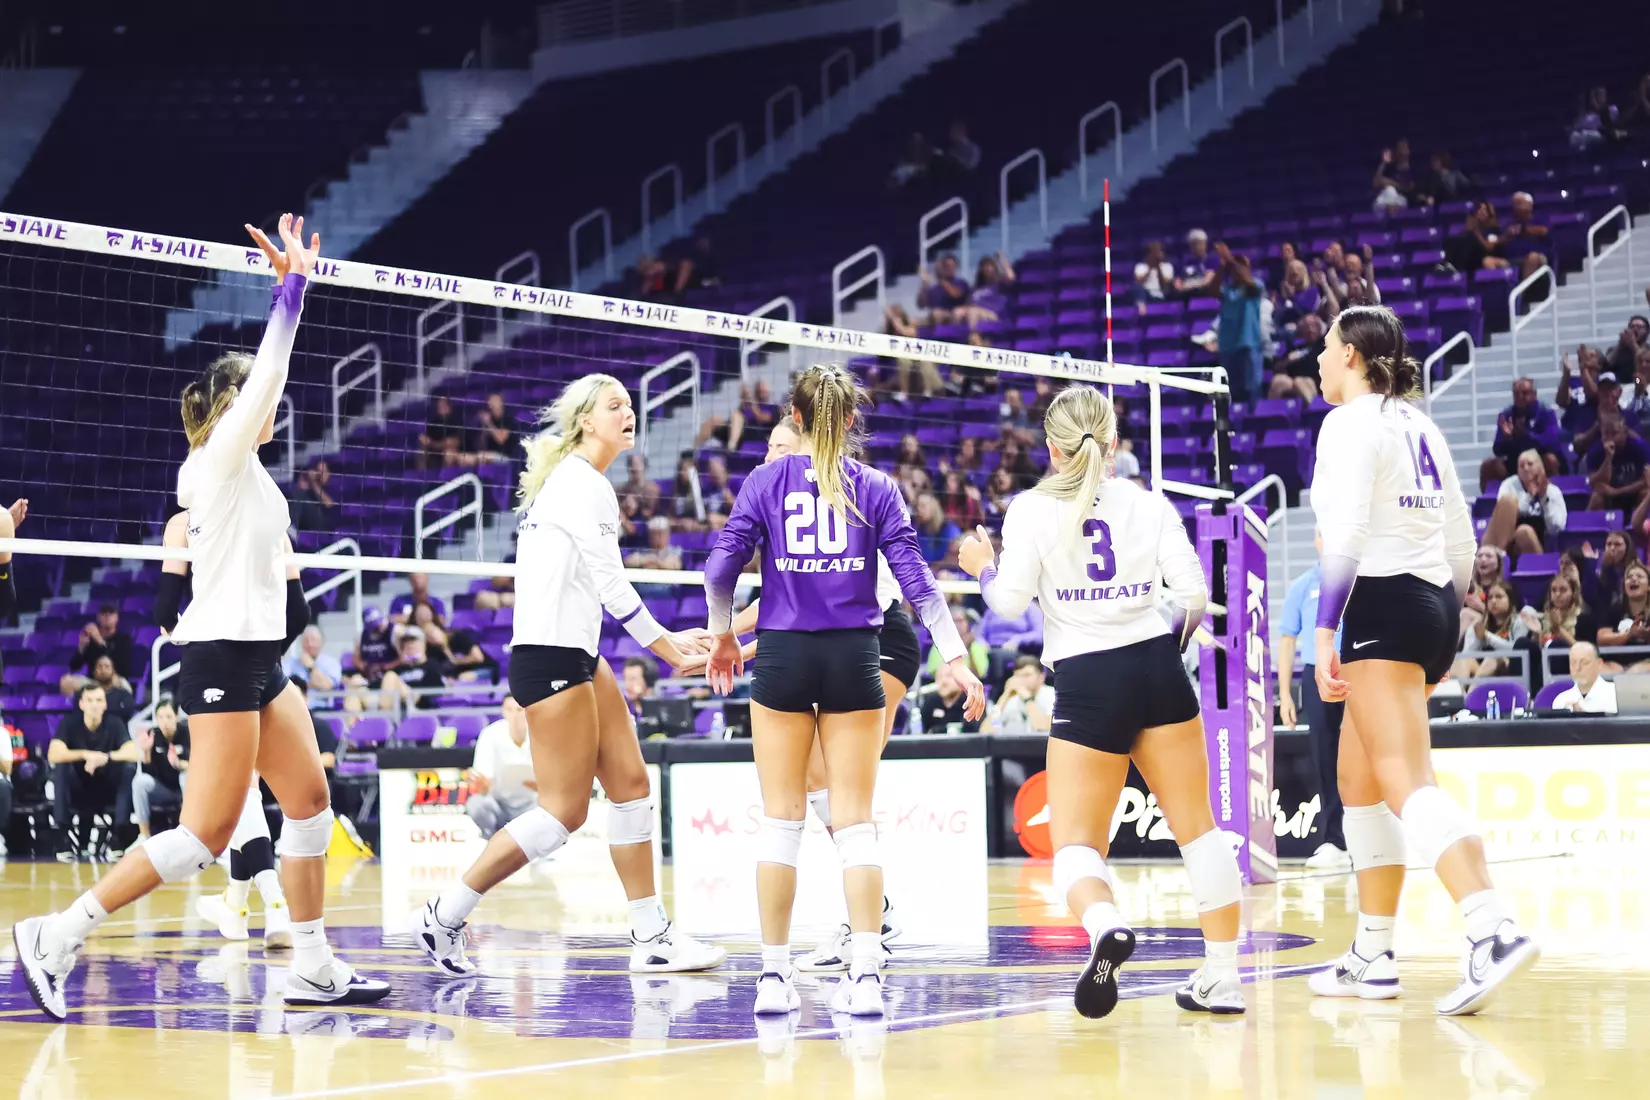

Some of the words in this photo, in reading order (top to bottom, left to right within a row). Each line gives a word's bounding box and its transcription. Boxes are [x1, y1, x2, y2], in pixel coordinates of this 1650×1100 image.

[130, 233, 210, 261] K-STATE
[394, 271, 463, 295] K-STATE
[511, 287, 575, 309] K-STATE
[620, 302, 679, 323] K-STATE
[720, 316, 776, 336] K-STATE
[815, 327, 868, 348] K-STATE
[904, 340, 951, 360] K-STATE
[985, 350, 1030, 368] K-STATE
[1062, 357, 1105, 378] K-STATE
[1404, 430, 1443, 491] 14
[784, 491, 848, 555] 20
[1082, 518, 1117, 582] 3
[774, 556, 866, 573] WILDCATS
[1055, 580, 1153, 602] WILDCATS
[1246, 569, 1271, 822] K-STATE
[410, 829, 467, 843] GMC
[1482, 828, 1635, 844] MEXICAN
